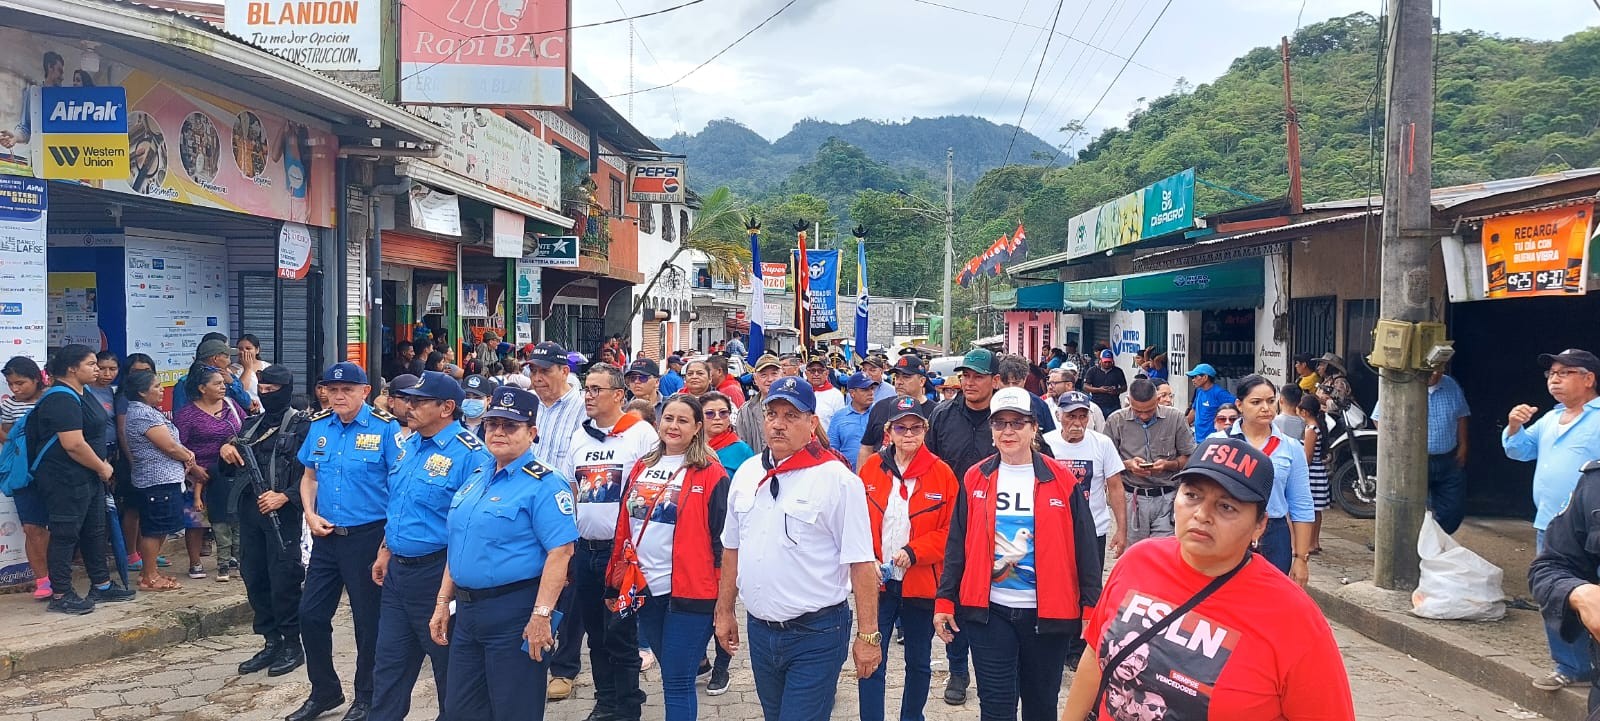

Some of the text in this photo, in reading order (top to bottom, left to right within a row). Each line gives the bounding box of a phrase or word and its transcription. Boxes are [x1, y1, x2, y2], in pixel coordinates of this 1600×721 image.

[247, 1, 359, 25] BLANDON
[252, 32, 268, 44] Tu
[50, 101, 118, 122] AirPak
[83, 147, 125, 157] Western
[83, 157, 114, 168] Union
[635, 166, 680, 178] PEPSI
[1514, 223, 1559, 239] RECARGA
[16, 244, 44, 254] LAFISE
[1514, 239, 1552, 251] TU DÍA CON
[1536, 250, 1559, 262] VIBRA
[1122, 330, 1140, 342] NITRO
[1170, 352, 1186, 377] FERT
[585, 450, 615, 462] FSLN
[1200, 443, 1259, 479] FSLN
[1121, 594, 1227, 659] FSLN
[1155, 672, 1198, 697] VENCEDORES
[1172, 672, 1200, 689] SIEMPRE
